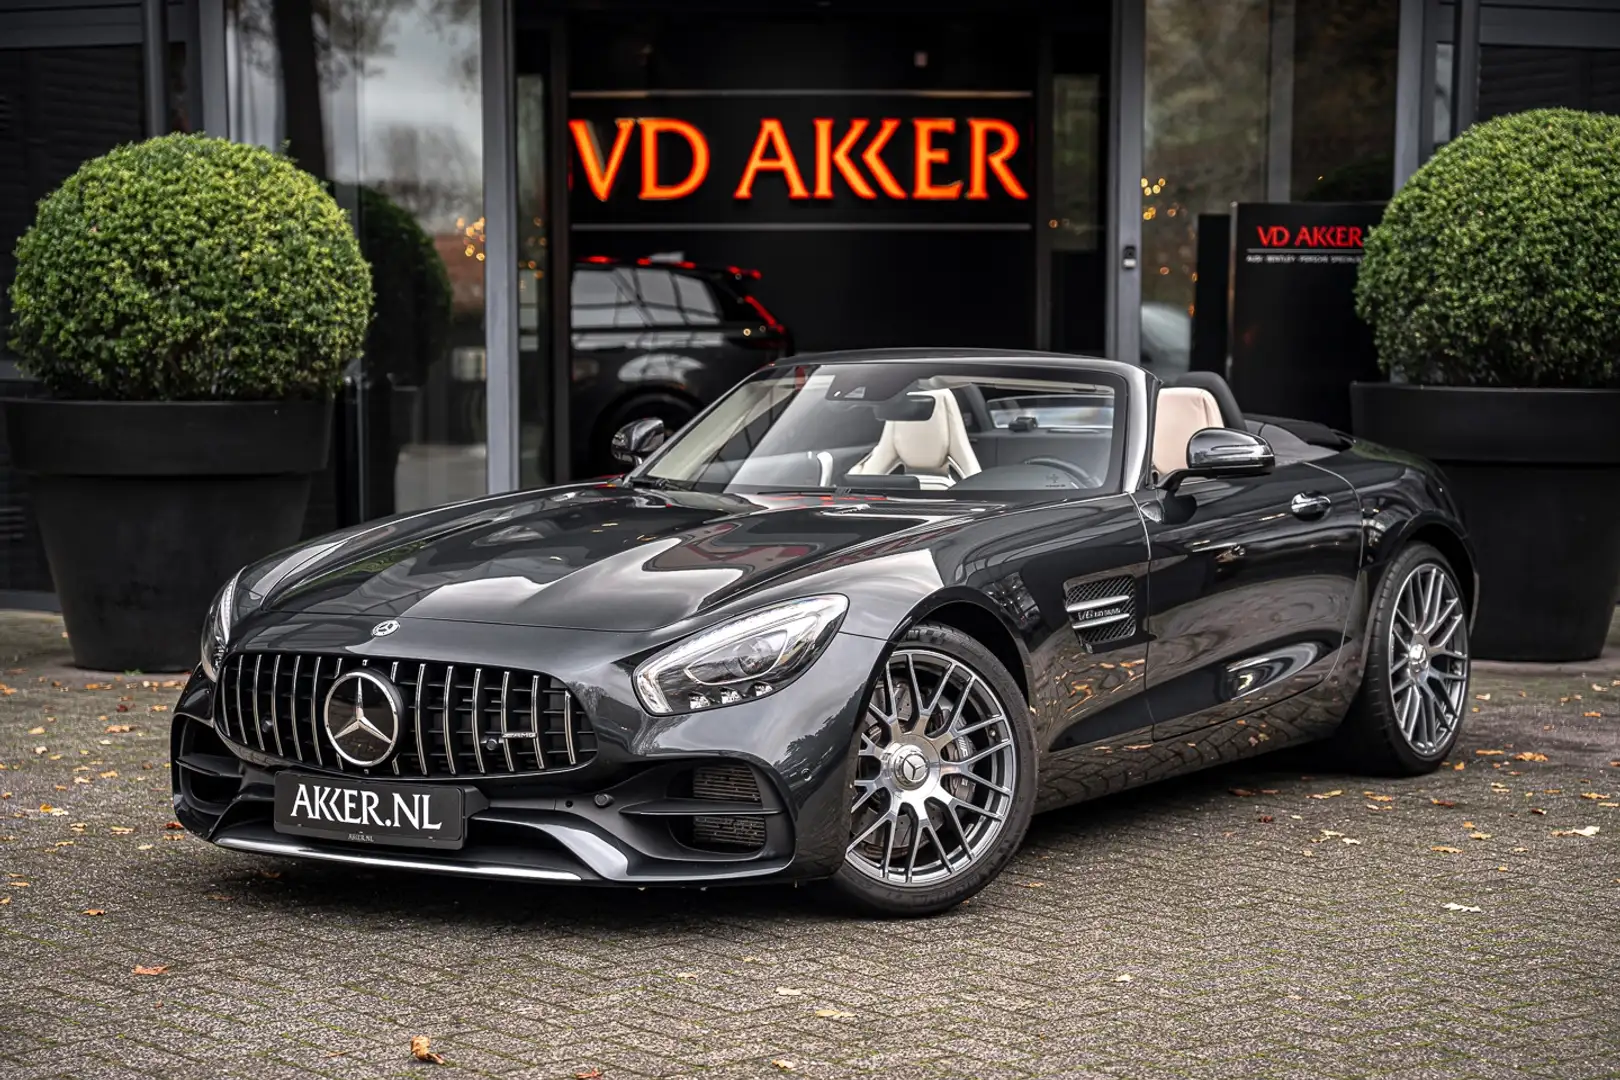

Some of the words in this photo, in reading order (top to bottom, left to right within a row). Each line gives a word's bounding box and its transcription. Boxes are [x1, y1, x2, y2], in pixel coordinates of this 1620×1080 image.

[568, 118, 710, 201] VD
[733, 118, 1028, 200] AKKER
[1256, 225, 1291, 248] VD
[1293, 225, 1363, 248] AKKER
[290, 783, 442, 831] AKKER.NL
